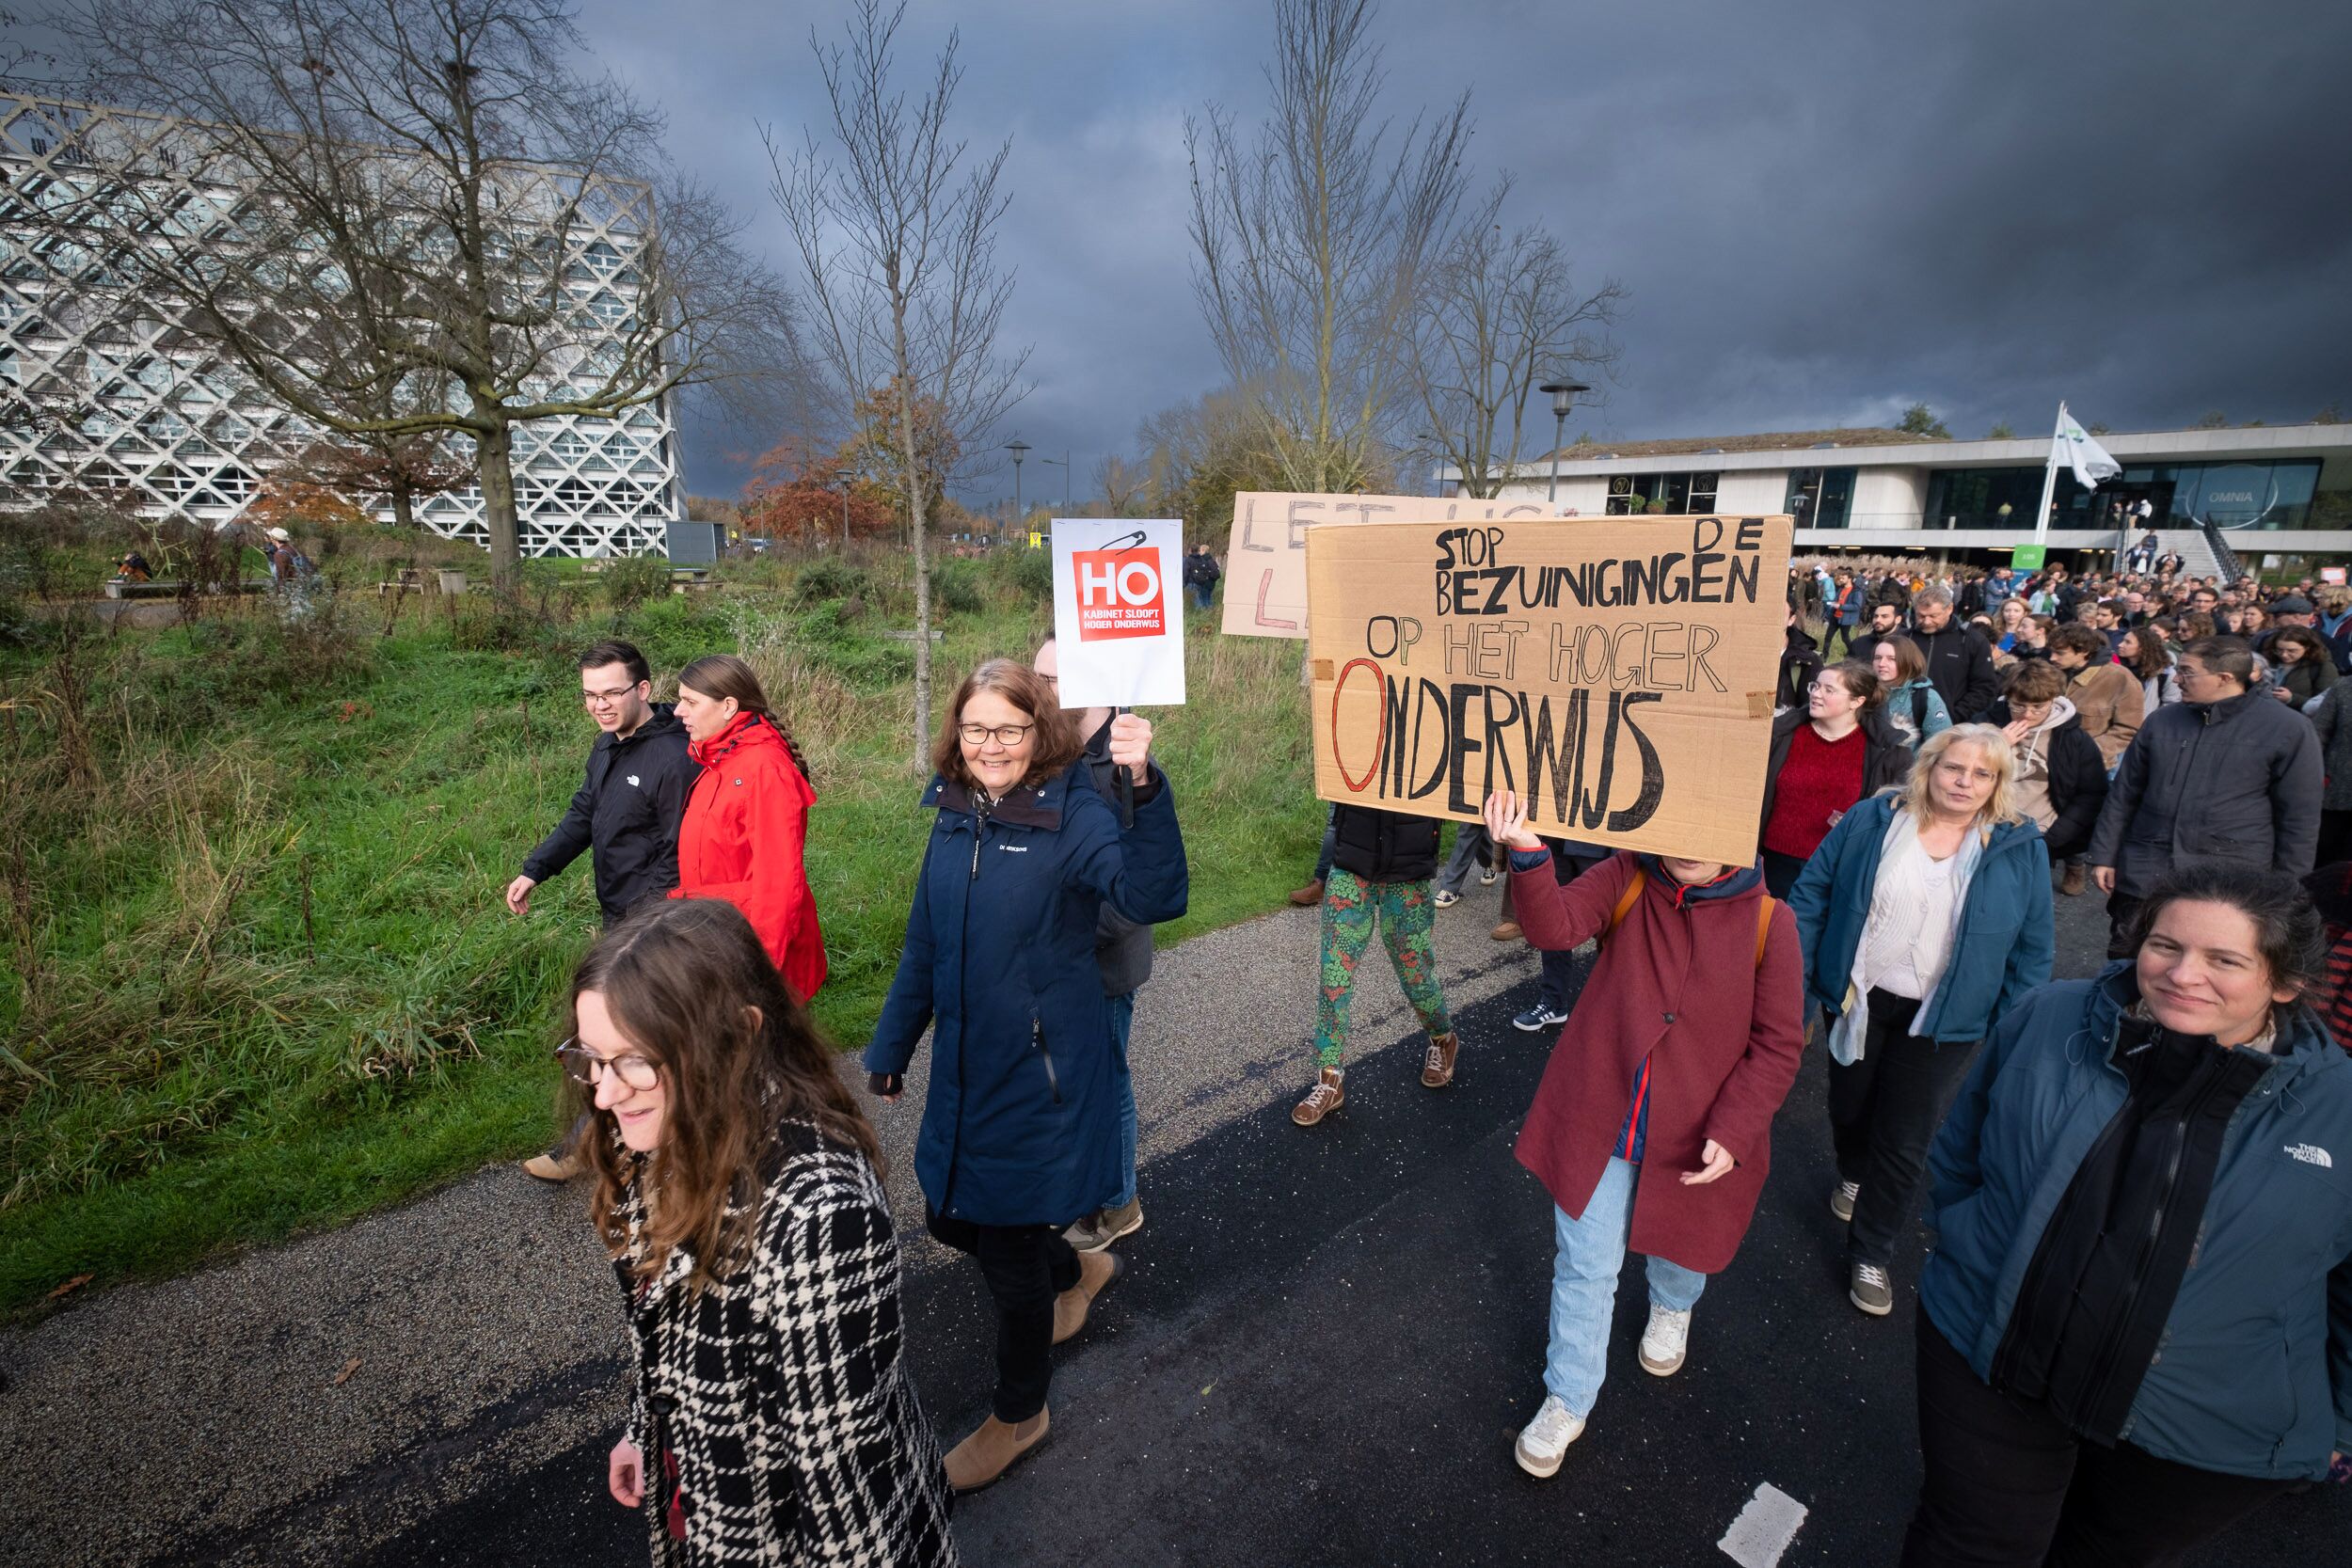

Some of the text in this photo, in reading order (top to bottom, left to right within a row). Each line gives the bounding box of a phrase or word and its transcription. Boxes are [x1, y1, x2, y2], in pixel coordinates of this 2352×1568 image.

[2209, 491, 2253, 502] OMNIA
[1436, 517, 1764, 570] STOP DE
[1083, 562, 1159, 606] HO
[1436, 553, 1760, 616] BEZUINIGINGEN
[1084, 609, 1159, 619] KABINET SLOOPT
[1084, 620, 1112, 629] HOGER
[1367, 615, 1728, 692] OP HET HOGER
[1331, 657, 1664, 832] ONDERWIJS
[2284, 1146, 2317, 1159] NORTH
[2298, 1143, 2317, 1152] THE
[2293, 1153, 2317, 1164] FACE
